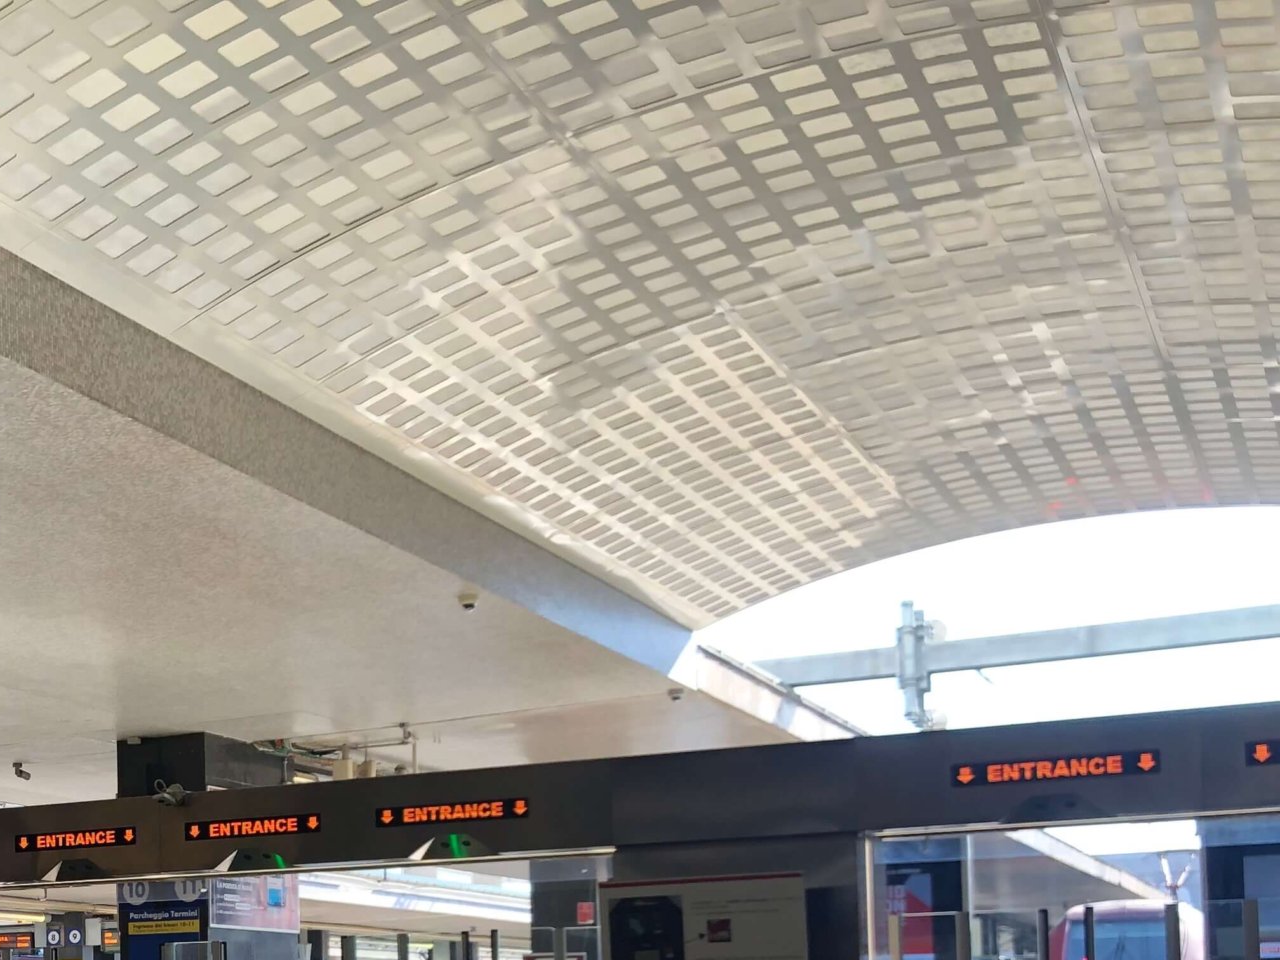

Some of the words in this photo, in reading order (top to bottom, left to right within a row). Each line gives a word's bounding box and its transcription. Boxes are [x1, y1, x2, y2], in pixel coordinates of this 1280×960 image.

[987, 756, 1122, 782] ENTRANCE
[403, 801, 503, 823] ENTRANCE
[209, 817, 297, 837] ENTRANCE
[36, 830, 115, 848] ENTRANCE
[128, 882, 145, 897] 10
